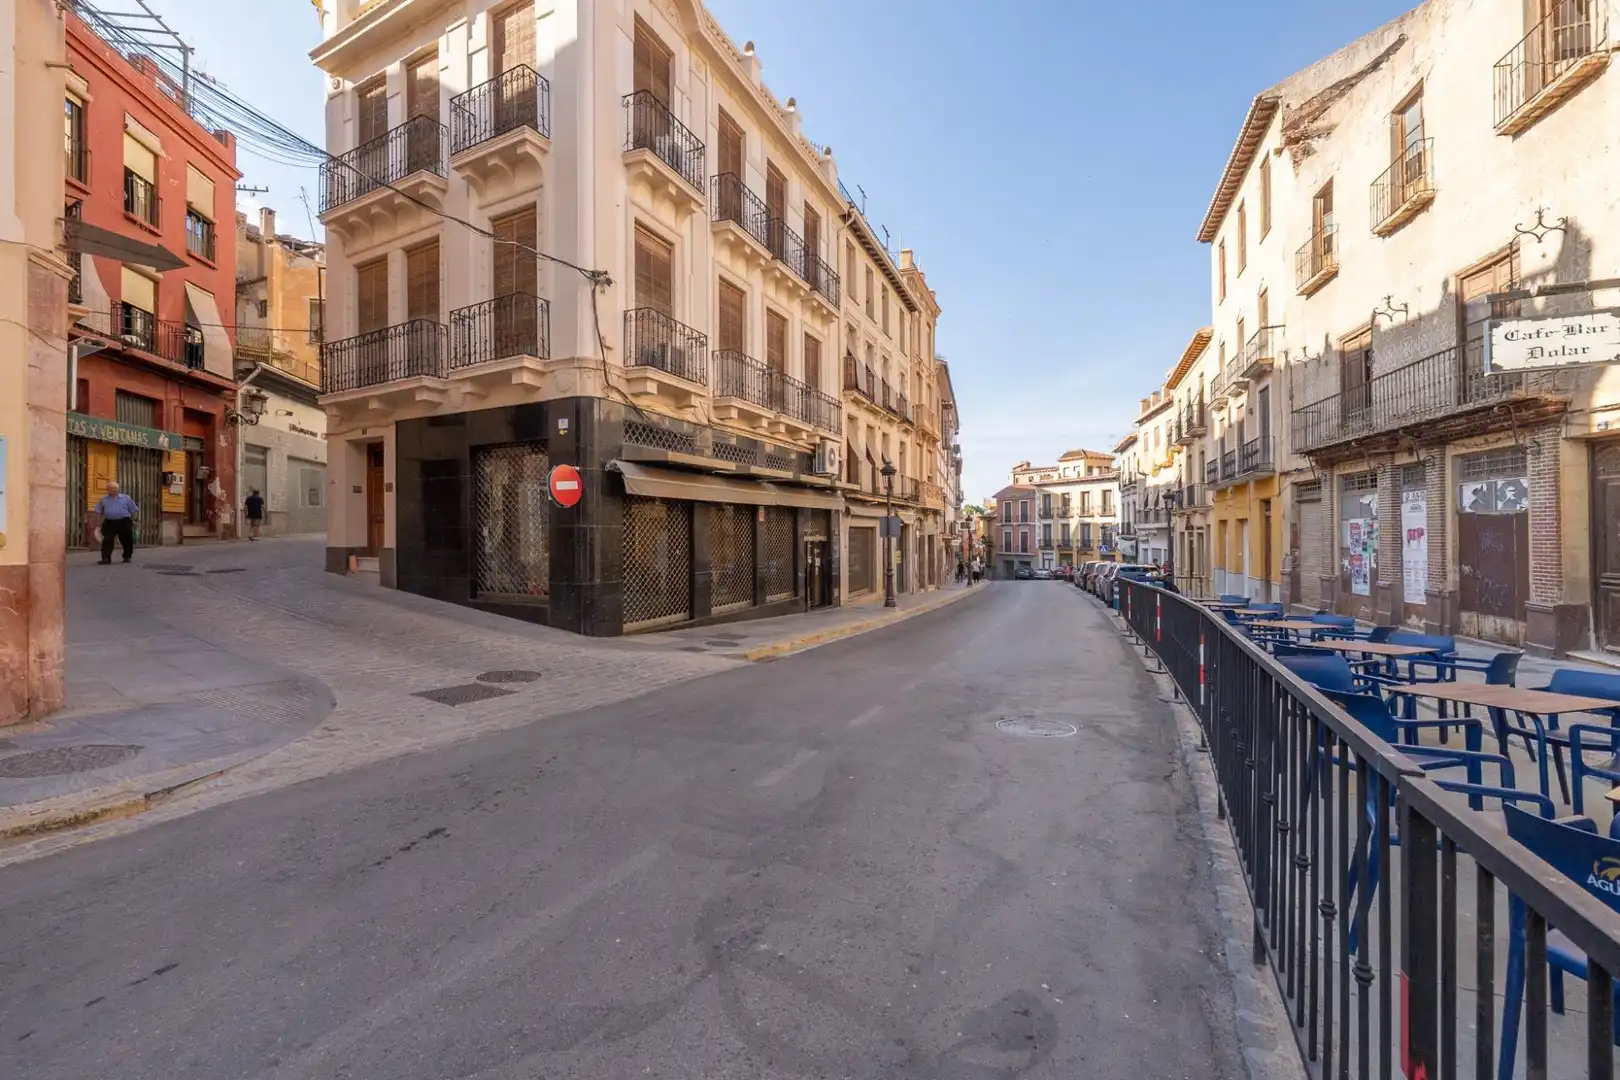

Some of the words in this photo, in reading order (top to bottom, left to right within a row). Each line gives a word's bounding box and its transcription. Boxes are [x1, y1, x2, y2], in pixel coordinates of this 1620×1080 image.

[1525, 345, 1590, 363] Dolar
[89, 423, 98, 439] Y
[101, 425, 149, 445] VENTANAS
